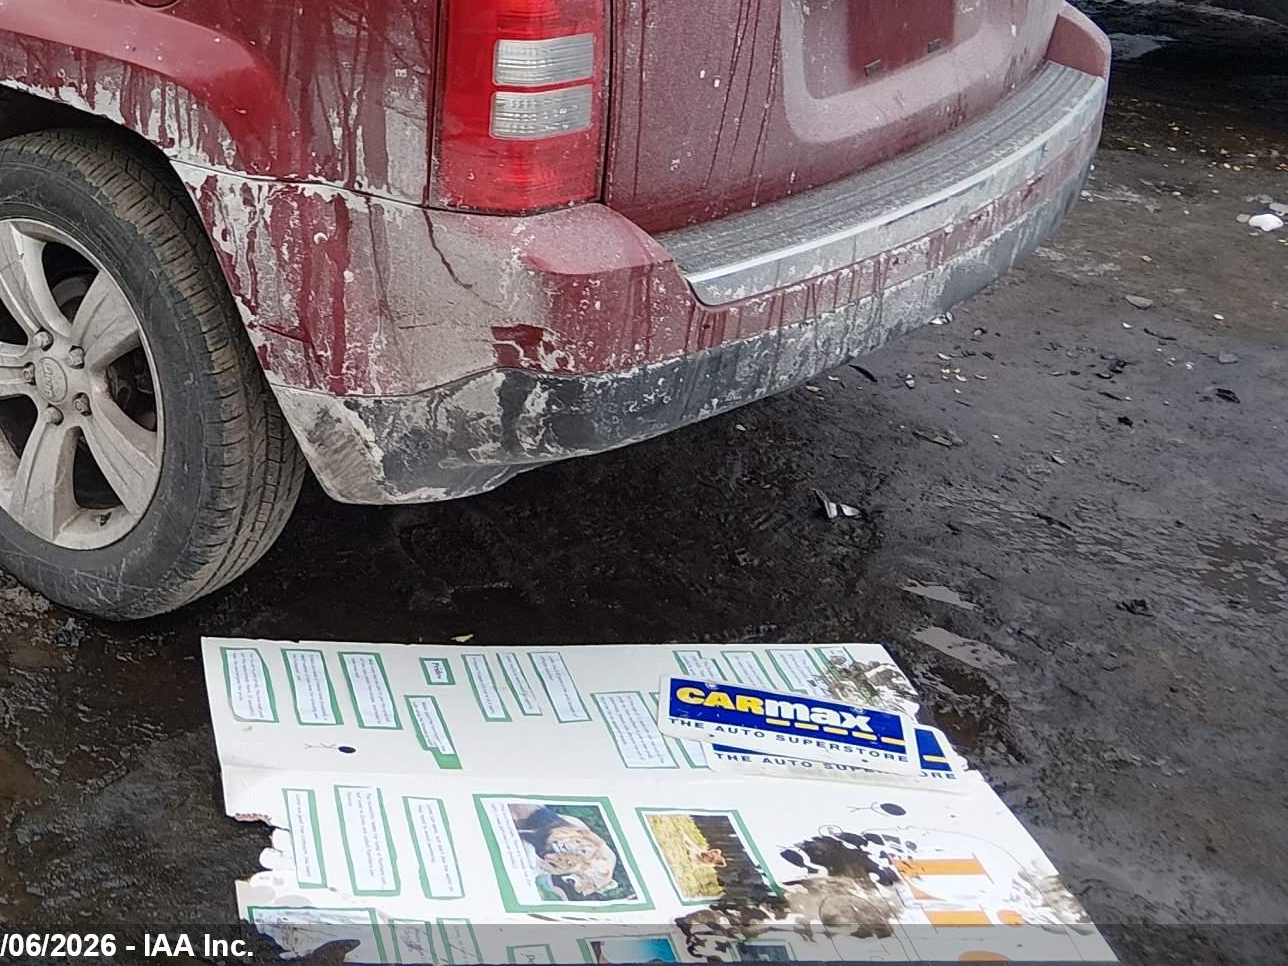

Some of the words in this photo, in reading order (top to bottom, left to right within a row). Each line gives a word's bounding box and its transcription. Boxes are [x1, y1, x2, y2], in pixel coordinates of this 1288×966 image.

[670, 718, 705, 730] THE
[714, 725, 766, 738] AUTO
[775, 734, 909, 763] SUPERSTORE
[714, 752, 753, 763] THE
[762, 757, 813, 768] AUTO
